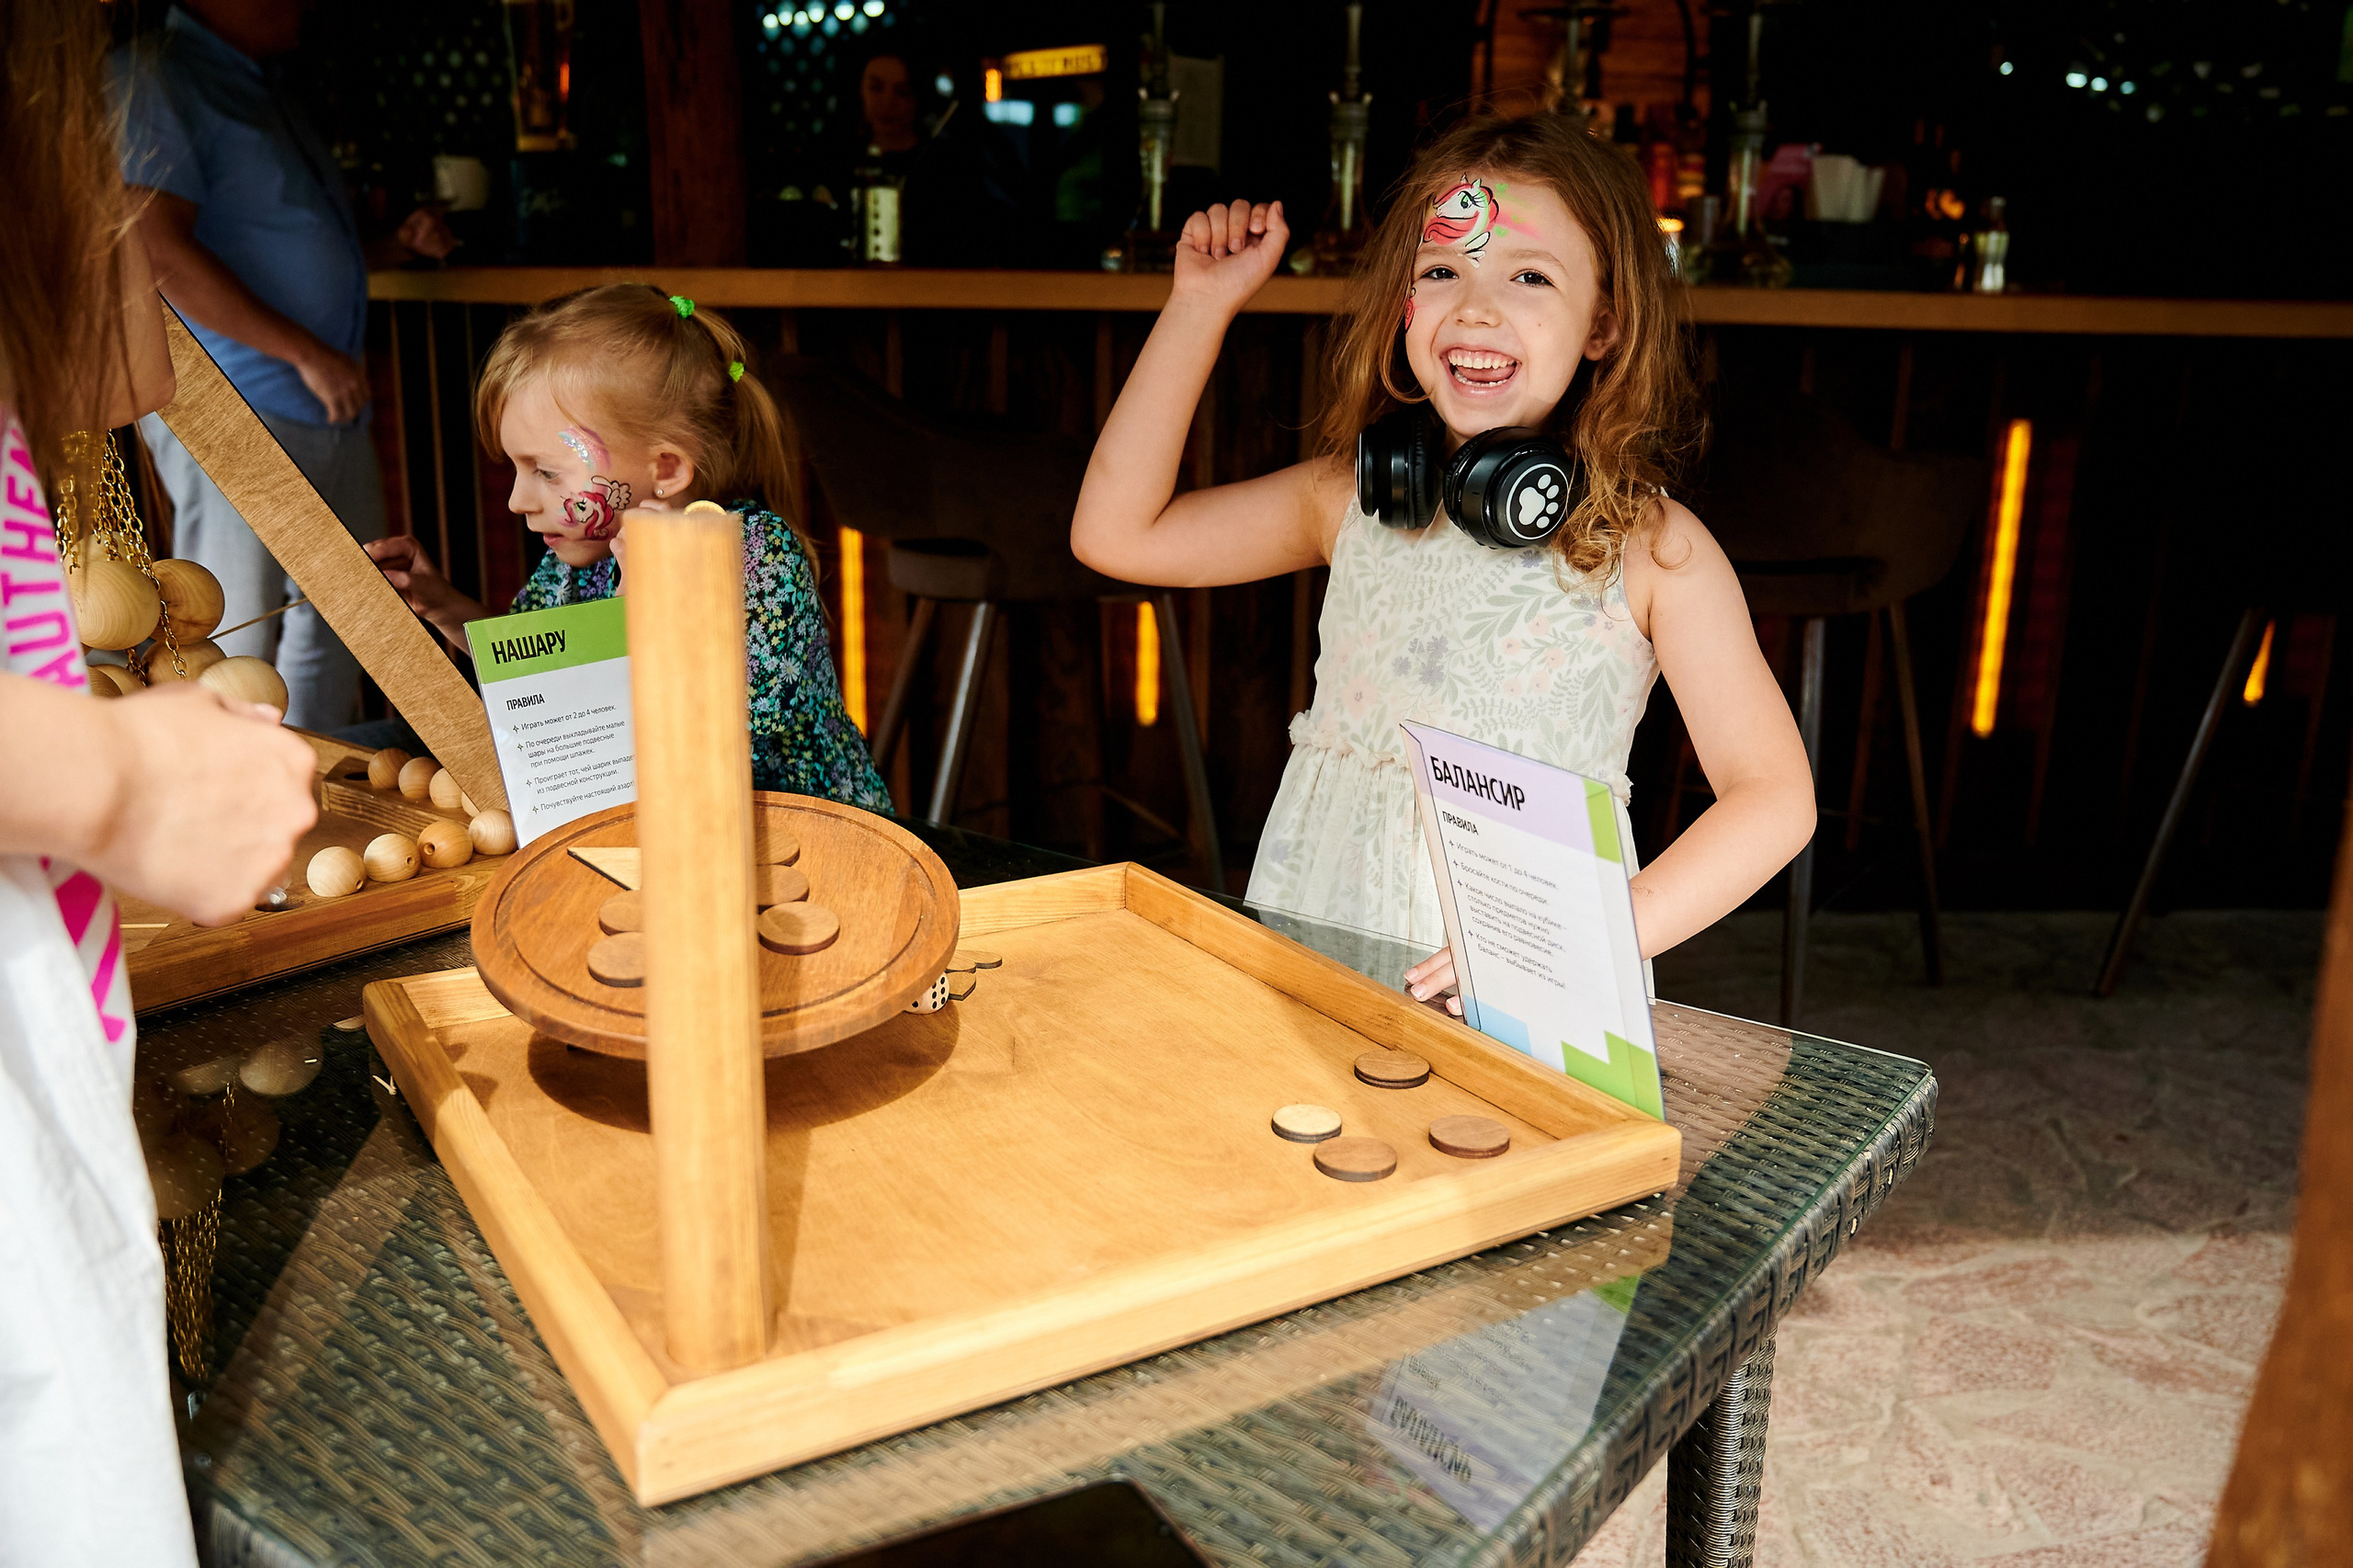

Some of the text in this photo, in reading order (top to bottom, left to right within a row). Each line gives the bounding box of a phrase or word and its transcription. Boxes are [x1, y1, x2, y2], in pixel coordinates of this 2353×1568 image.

[491, 630, 566, 665] НАШАРУ
[506, 694, 545, 710] ПРАВИЛА
[521, 722, 544, 731] Играть
[544, 716, 564, 726] может
[591, 704, 617, 714] человек.
[529, 750, 546, 759] шары
[555, 741, 582, 752] большие
[583, 733, 615, 745] подвесные
[536, 735, 563, 747] очереди
[563, 725, 606, 739] выкладывайте
[606, 721, 625, 730] малые
[530, 748, 596, 769] при помощи шпажек.
[535, 771, 567, 784] Проиграет
[581, 764, 591, 773] чей
[592, 761, 611, 770] шарик
[540, 780, 635, 811] Почувствуйте настоящий азарт!
[546, 778, 578, 792] подвесной
[579, 769, 619, 783] конструкции.
[1430, 756, 1526, 812] БАЛАНСИР
[1442, 811, 1479, 835] ПРАВИЛА
[1457, 842, 1478, 858] Играть
[1479, 854, 1499, 867] может
[1513, 868, 1522, 876] до
[1461, 862, 1549, 905] Бросайте кости по очереди.
[1465, 882, 1483, 896] Какое
[1484, 892, 1503, 904] число
[1504, 901, 1528, 915] выпало
[1528, 912, 1537, 920] на
[1538, 915, 1562, 930] кубике
[1467, 894, 1550, 935] столько предметов нужно
[1470, 905, 1502, 925] выставить
[1511, 924, 1547, 944] подвесной
[1472, 916, 1501, 934] сохранив
[1502, 929, 1513, 938] его
[1475, 933, 1552, 973] Кто не сможет удержать
[1477, 943, 1500, 960] баланс
[1506, 957, 1537, 976] выбывает
[1538, 971, 1546, 981] из
